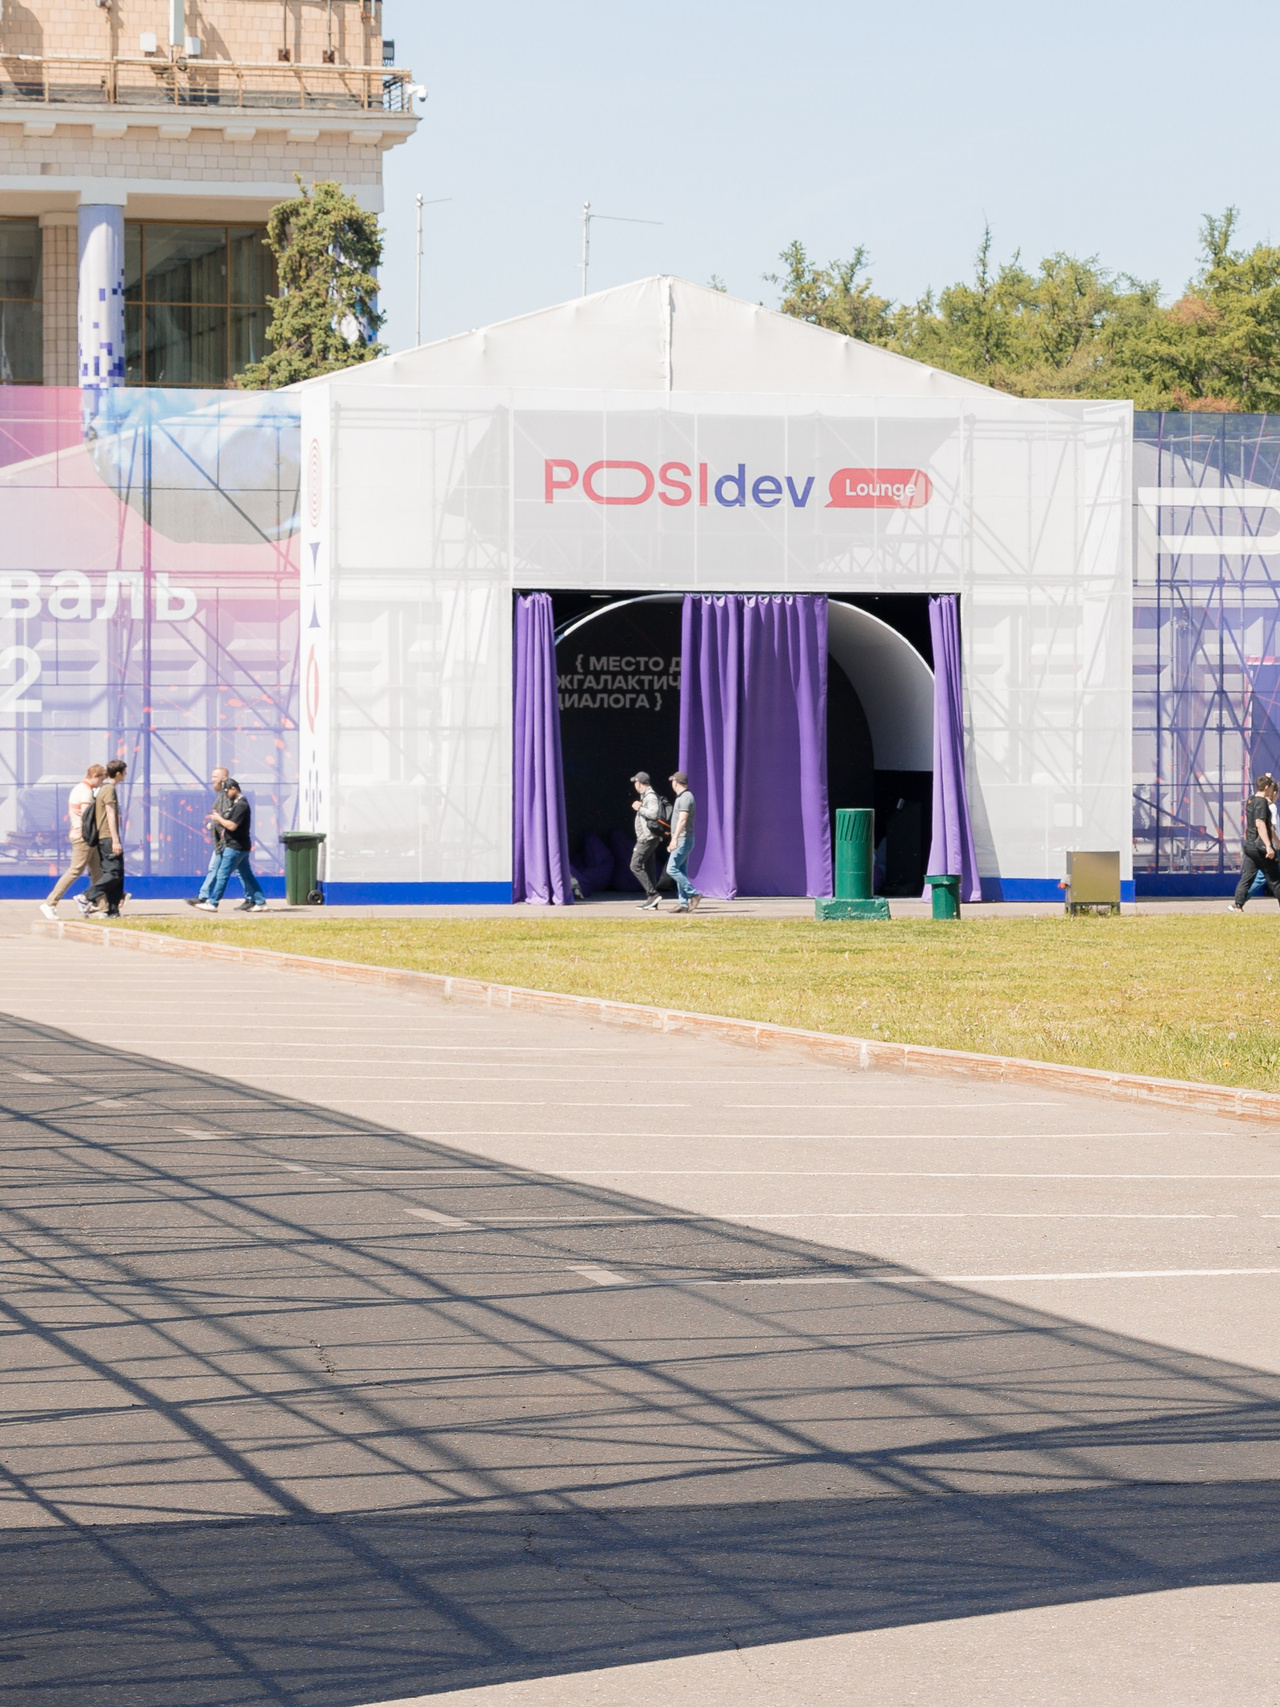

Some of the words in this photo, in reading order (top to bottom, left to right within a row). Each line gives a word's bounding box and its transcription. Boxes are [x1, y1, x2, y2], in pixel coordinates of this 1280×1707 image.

[845, 479, 917, 499] Lounge
[0, 569, 198, 621] валь
[589, 656, 665, 672] МЕСТО
